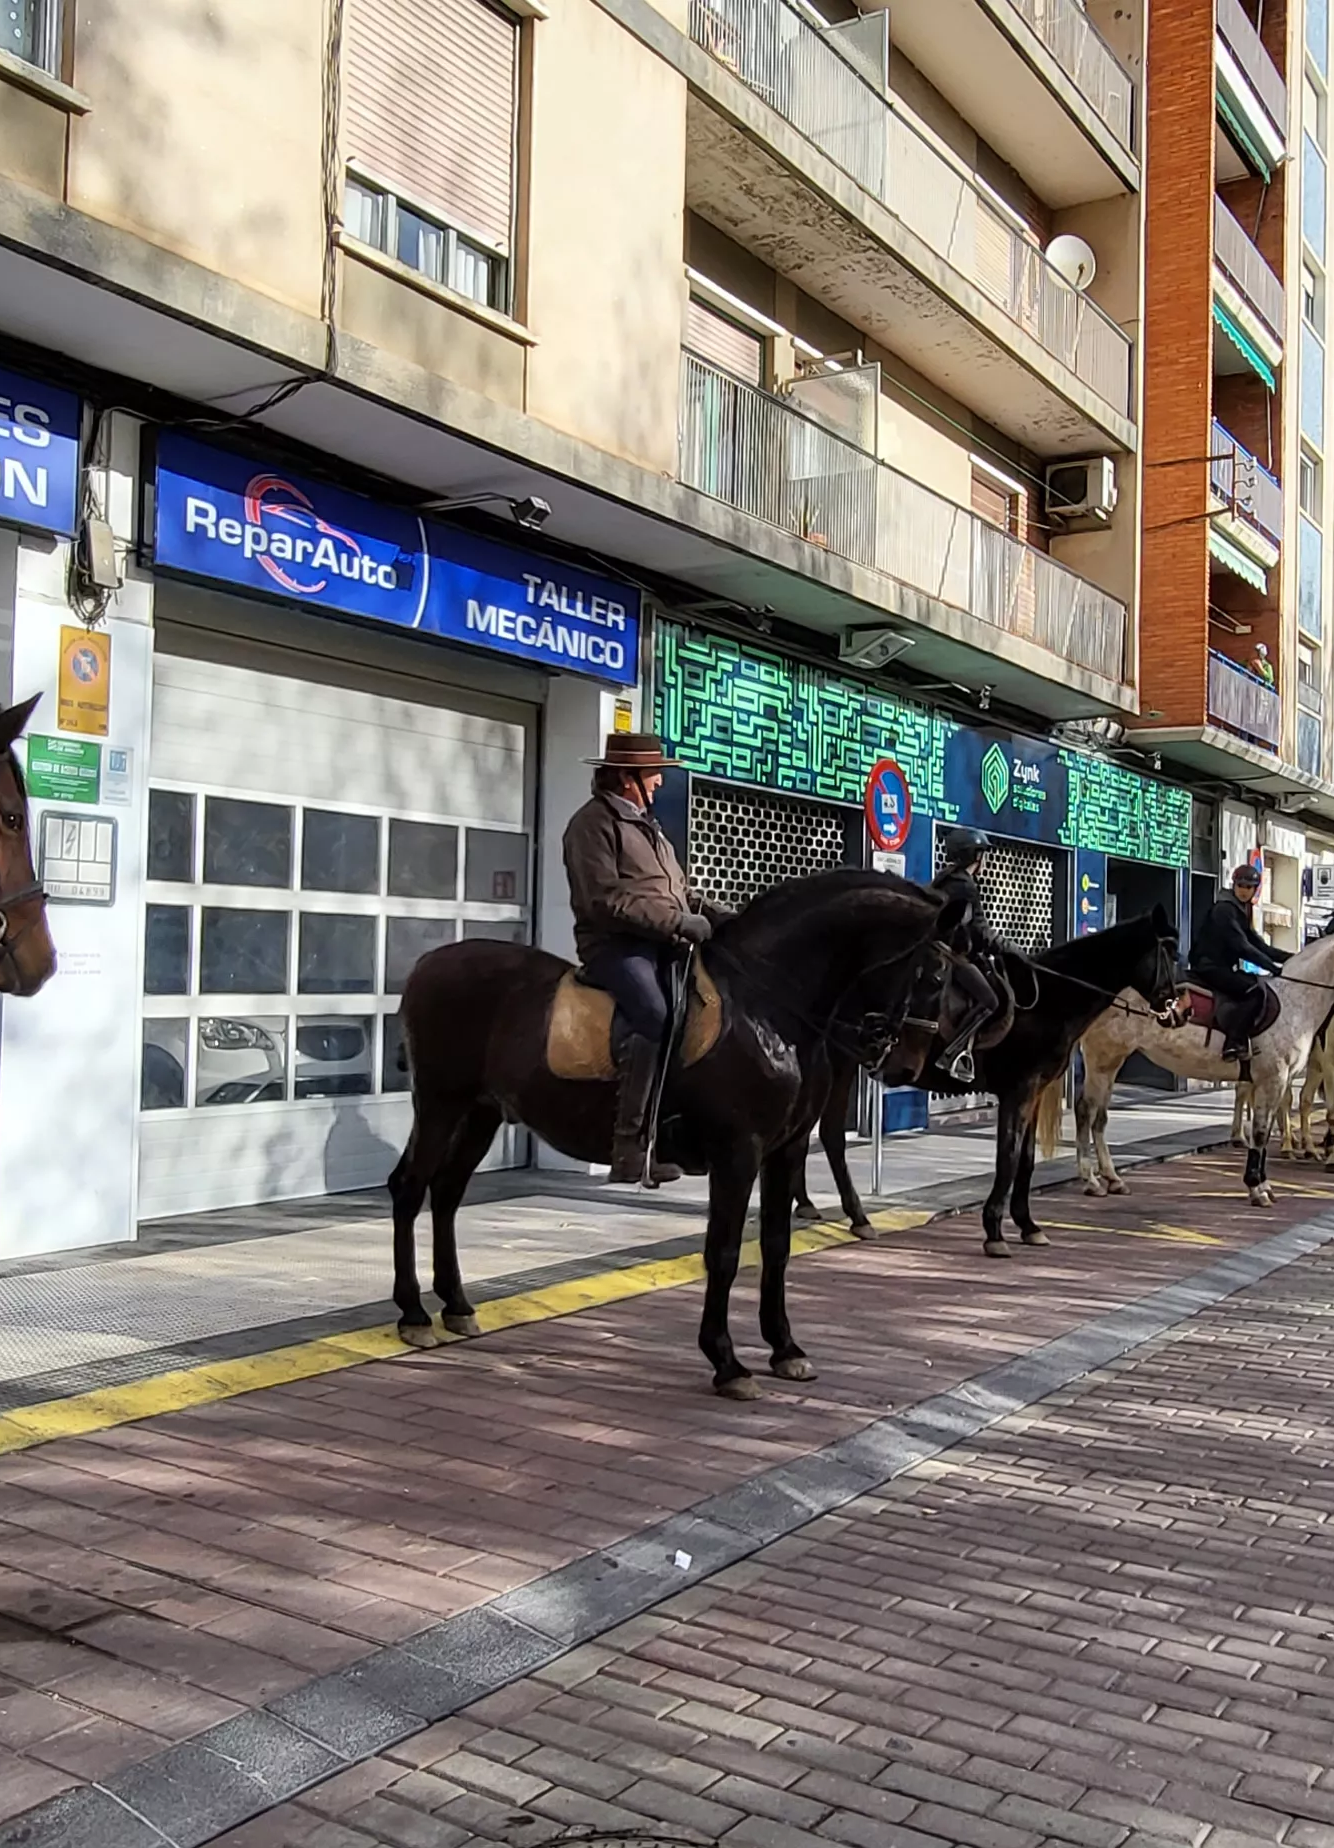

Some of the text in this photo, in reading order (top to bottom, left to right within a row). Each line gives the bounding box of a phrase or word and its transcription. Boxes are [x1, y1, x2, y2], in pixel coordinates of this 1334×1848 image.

[185, 497, 398, 590] ReparAuto
[466, 599, 625, 671] MECÁNICO
[522, 572, 626, 632] TALLER
[1012, 758, 1040, 784] Zynk
